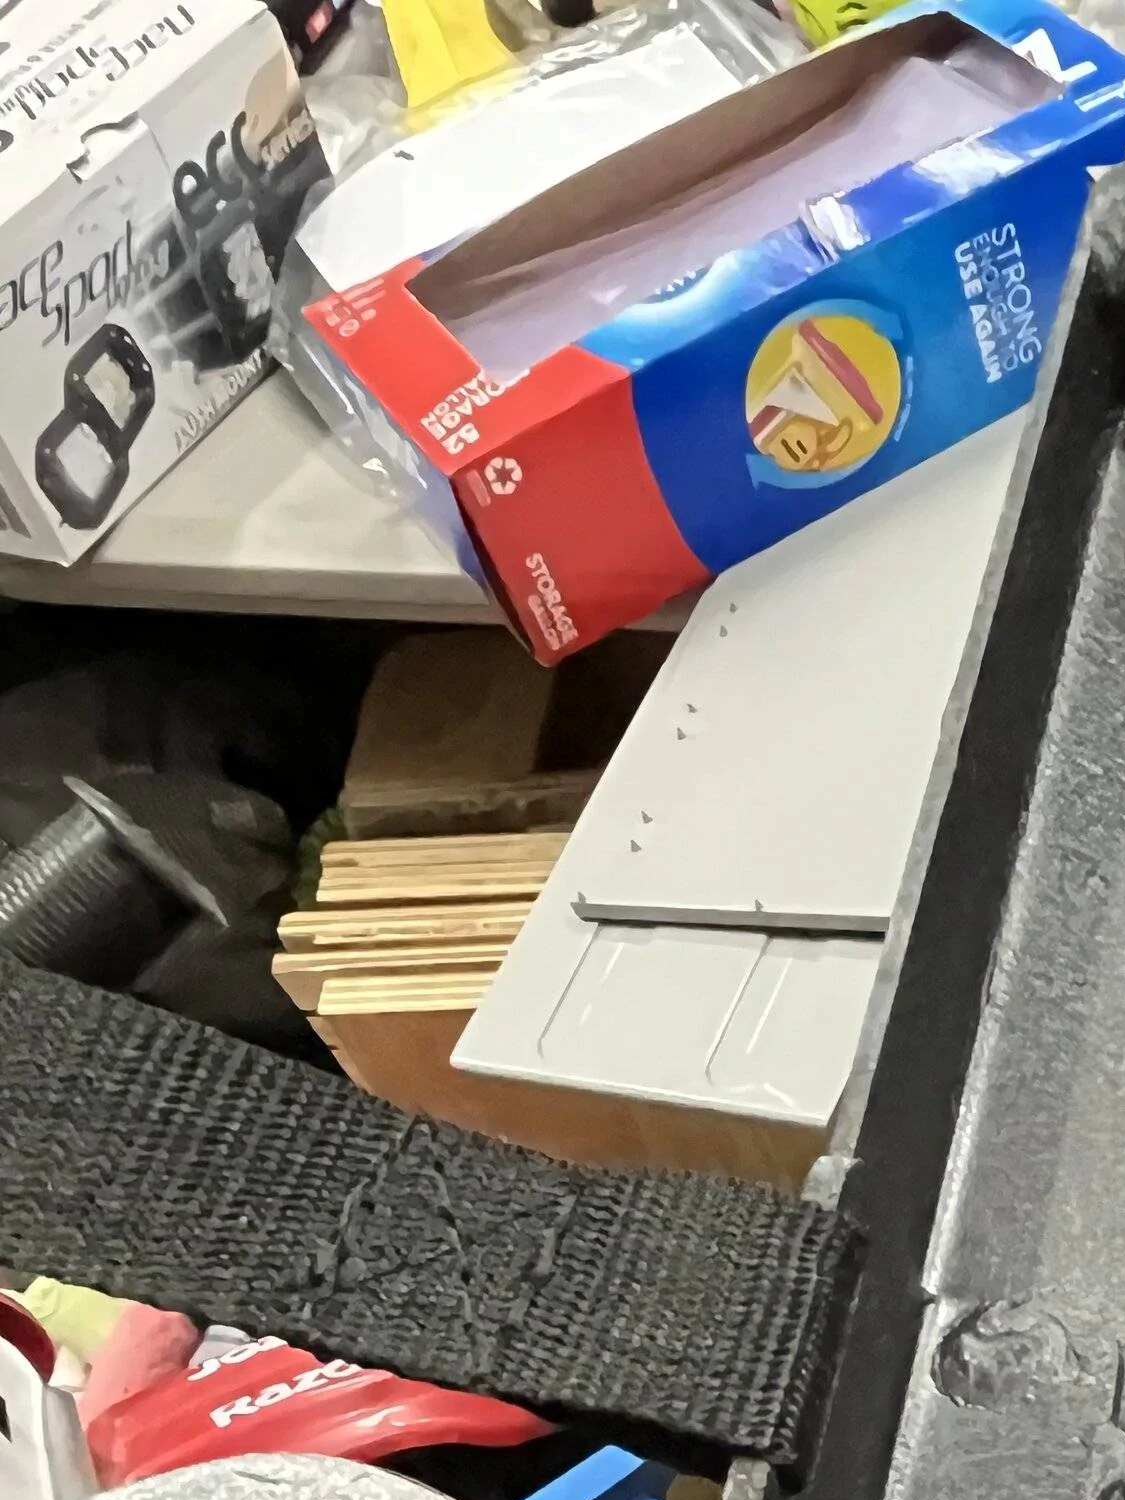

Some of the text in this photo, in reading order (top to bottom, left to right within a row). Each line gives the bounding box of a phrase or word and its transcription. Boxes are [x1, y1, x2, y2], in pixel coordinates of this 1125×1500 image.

[954, 241, 1003, 383] USE AGAIN
[973, 233, 1019, 371] ENOUGH TO
[991, 223, 1042, 363] STRONG
[525, 552, 579, 646] STORAGE
